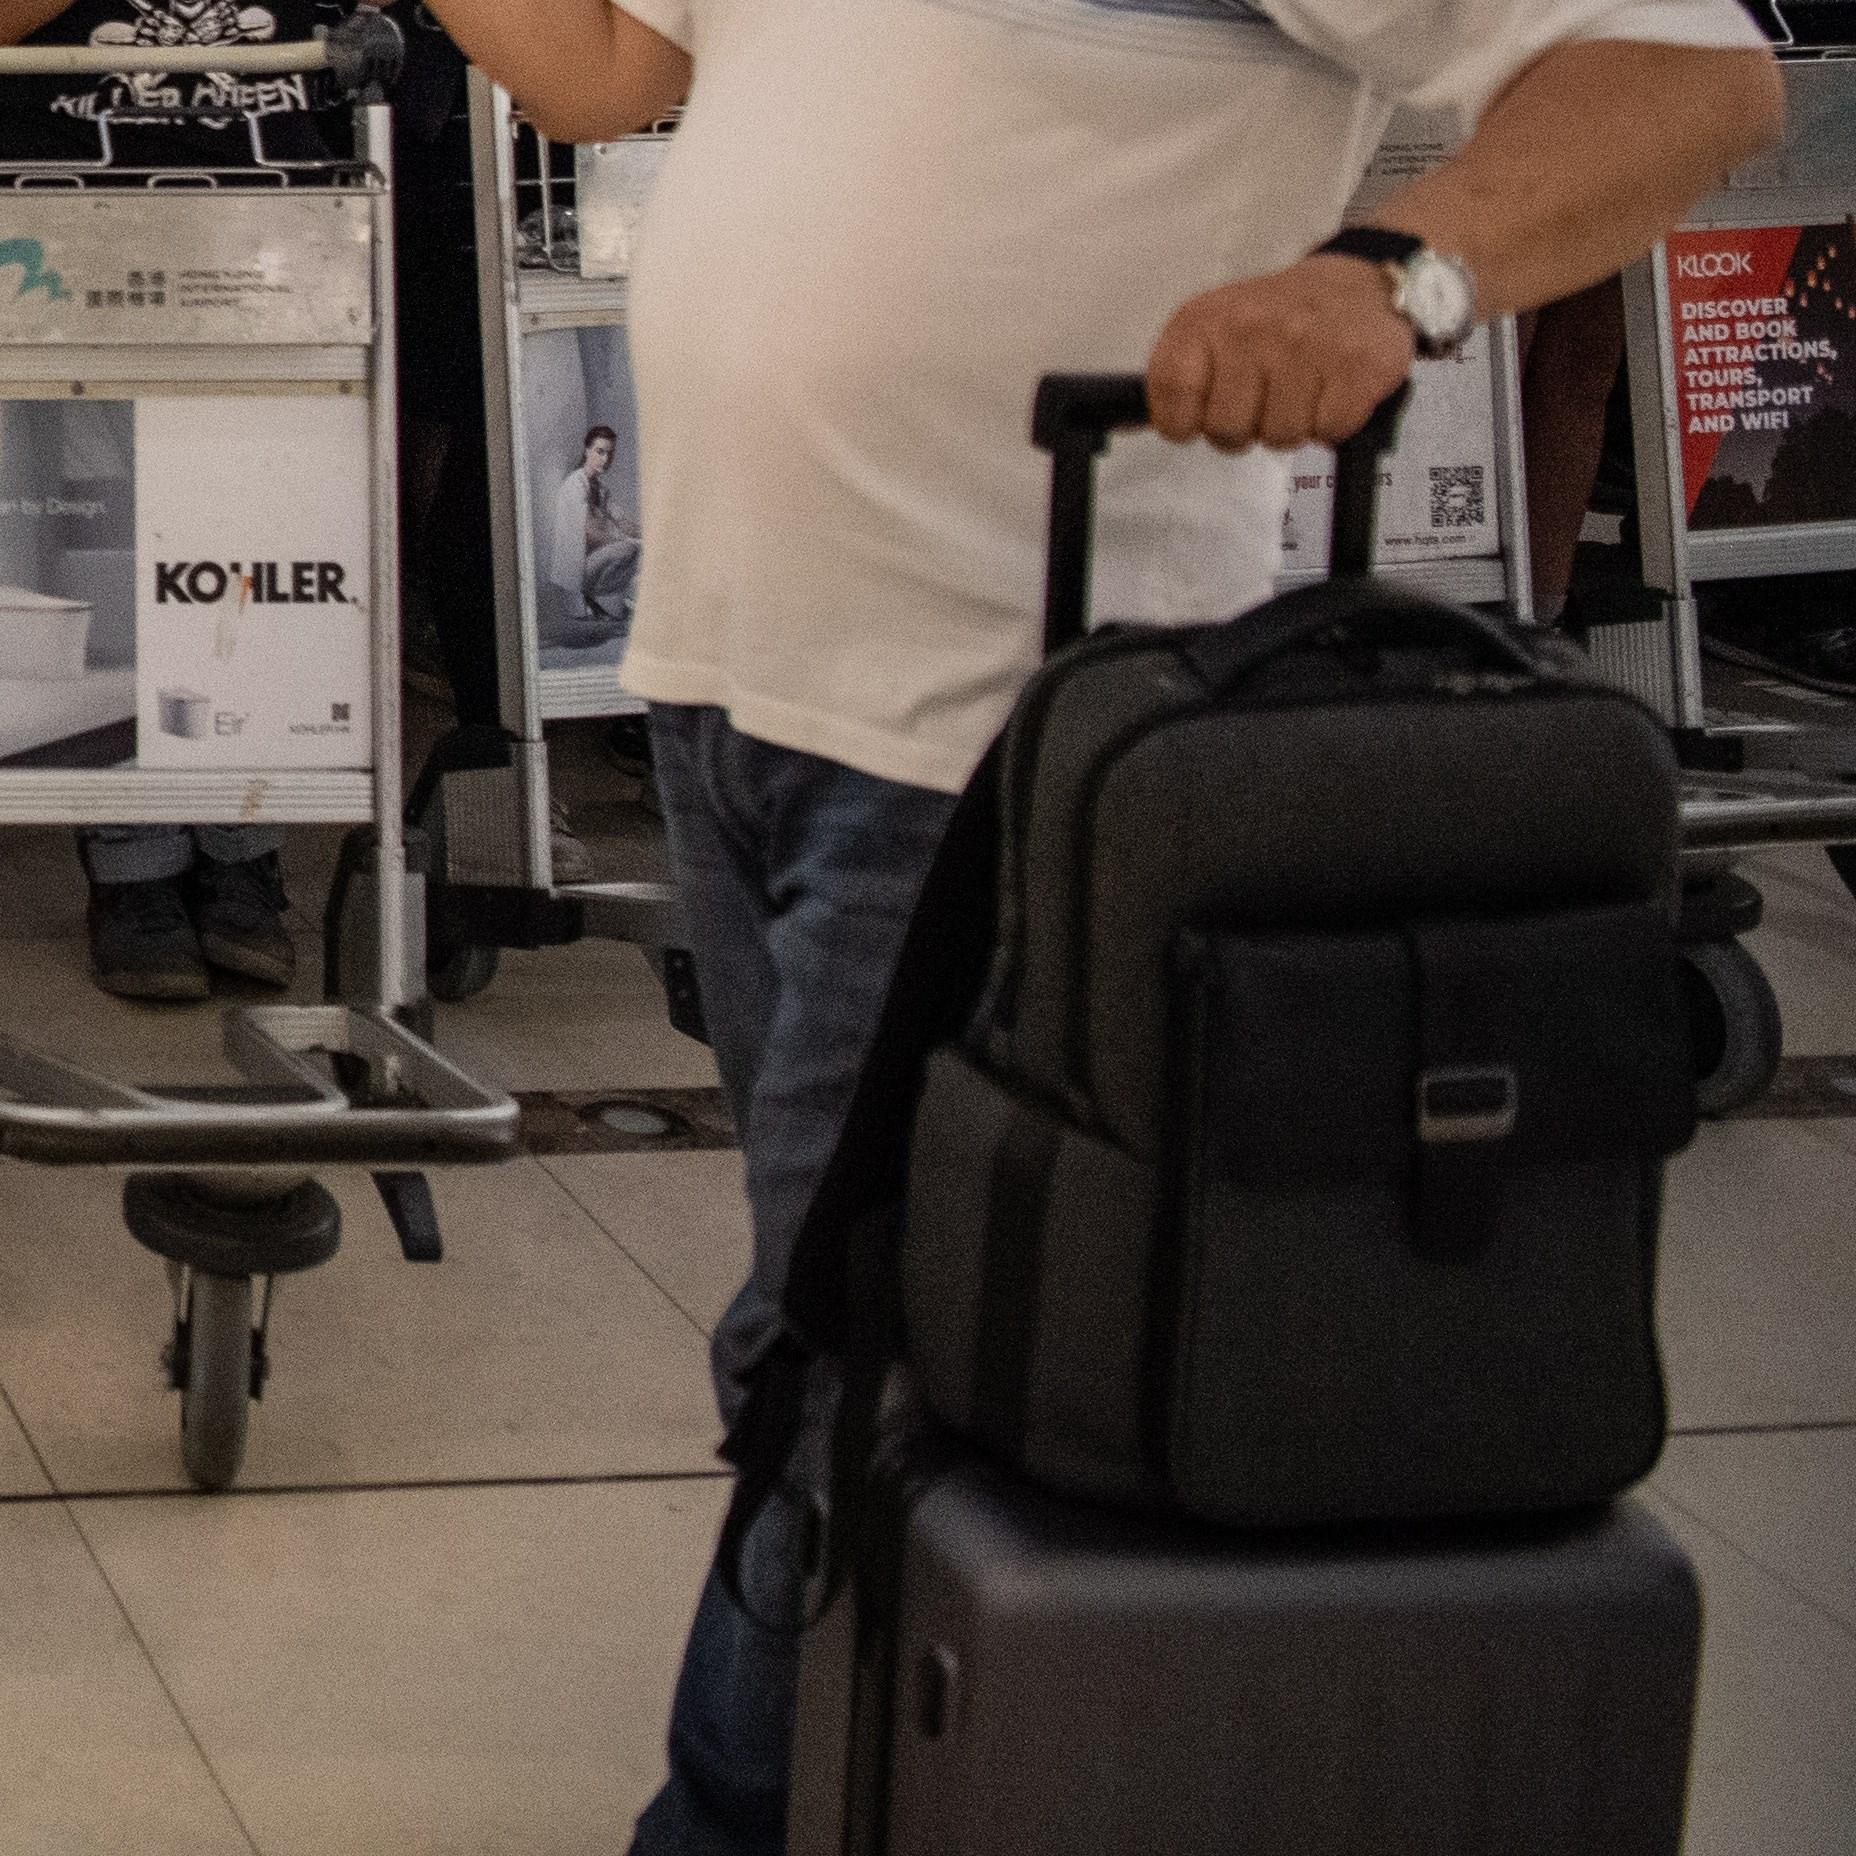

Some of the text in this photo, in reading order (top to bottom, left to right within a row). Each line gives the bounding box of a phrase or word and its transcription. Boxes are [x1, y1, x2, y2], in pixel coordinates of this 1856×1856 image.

[1677, 252, 1752, 279] KLOOK
[1680, 296, 1788, 320] DISCOVER
[1683, 316, 1798, 342] AND BOOK
[1684, 339, 1838, 366] ATTRACTIONS,
[1685, 366, 1764, 390] TOURS,
[1687, 386, 1814, 410] TRANSPORT
[1688, 412, 1790, 434] AND WIFI
[1291, 475, 1322, 493] your
